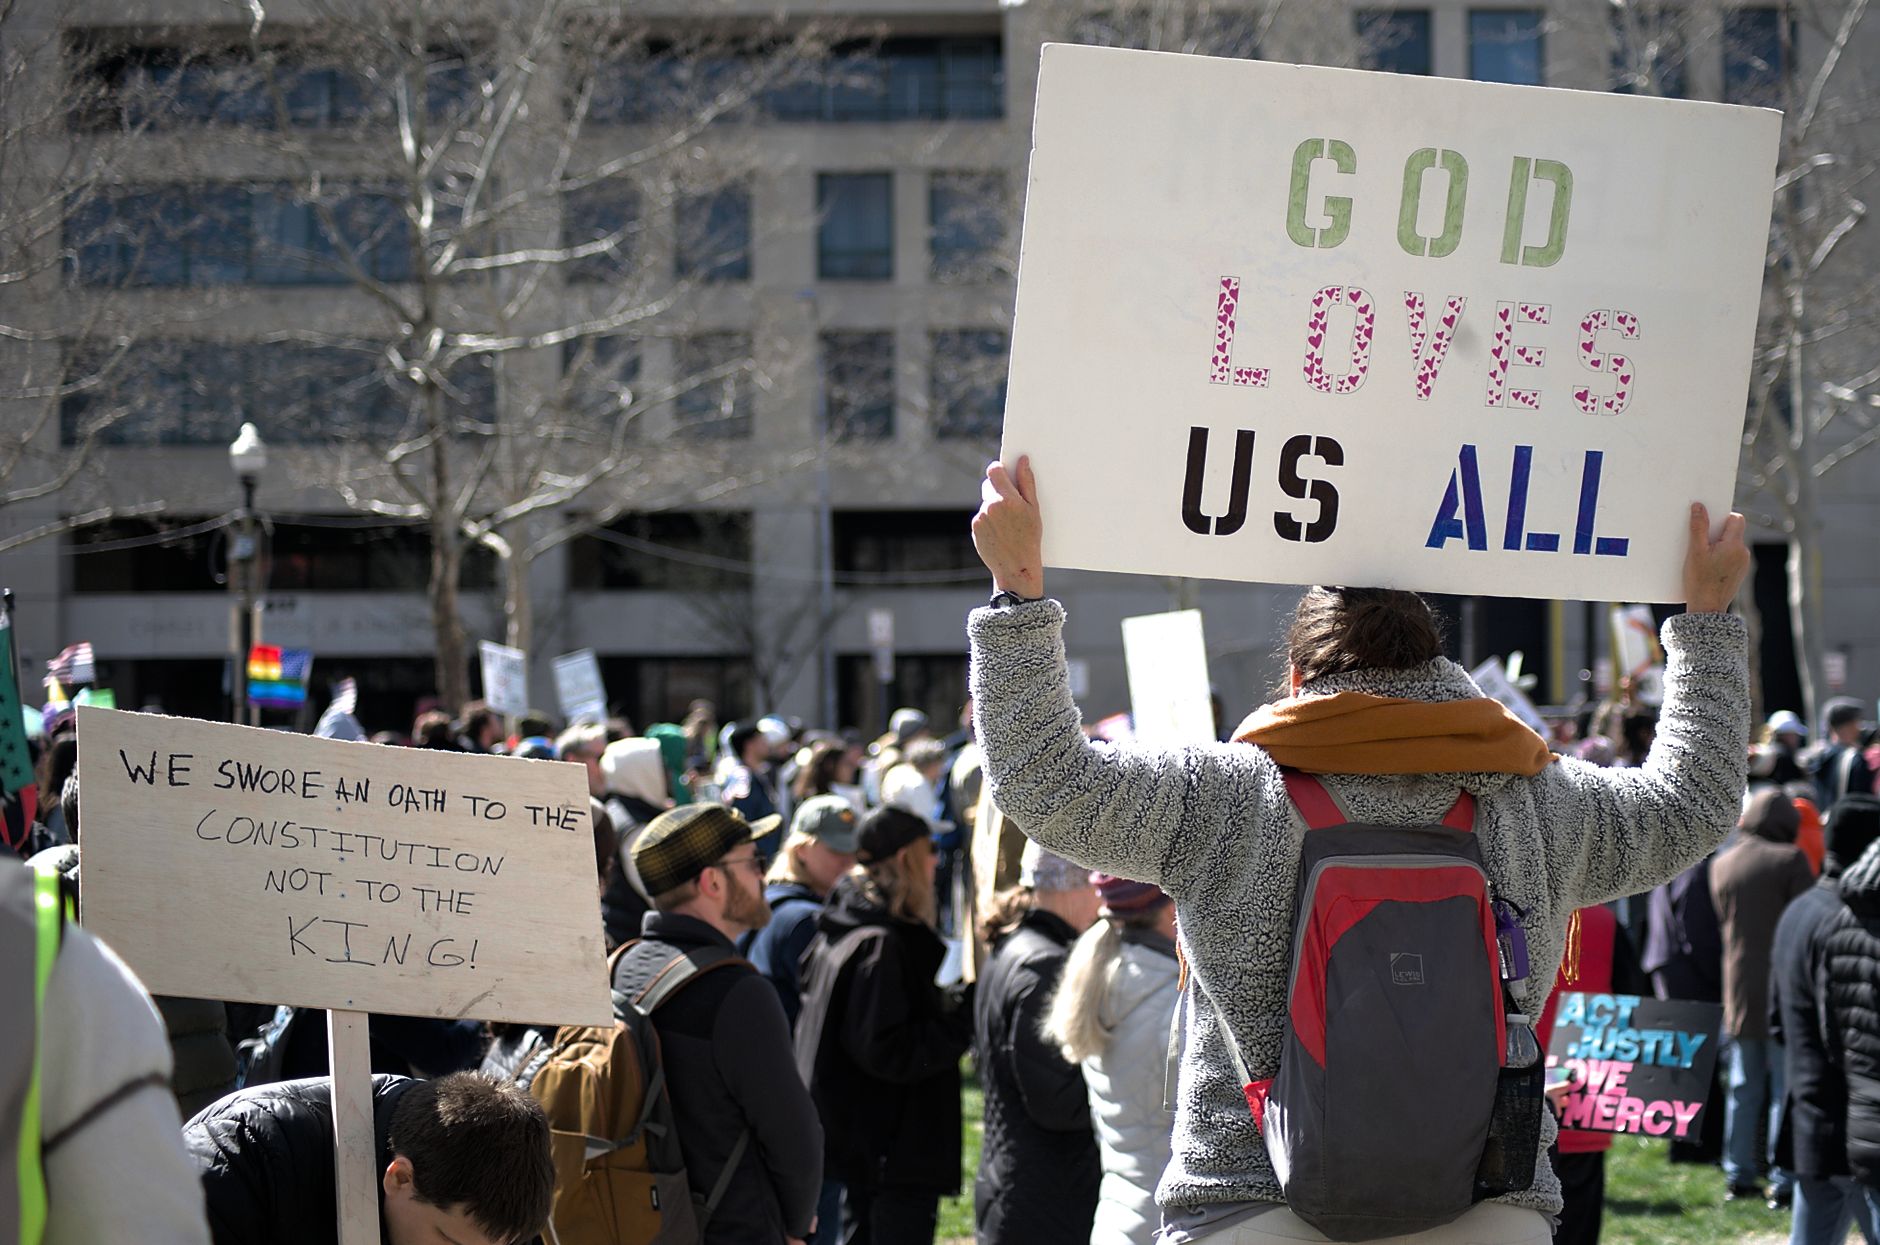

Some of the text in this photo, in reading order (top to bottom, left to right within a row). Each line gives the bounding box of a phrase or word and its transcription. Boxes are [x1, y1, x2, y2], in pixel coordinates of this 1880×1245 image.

[1286, 138, 1573, 267] GOD
[1209, 276, 1641, 416] LOVES
[1181, 426, 1629, 557] US ALL
[119, 749, 586, 831] WE SWORE AN OATH TO THE
[196, 809, 504, 876] CONSTITUTION
[265, 868, 475, 914] NOT TO THE
[287, 915, 479, 969] KING!
[1556, 992, 1641, 1030] ACT
[1567, 1024, 1707, 1068] JUSTLY
[1545, 1056, 1634, 1097] OVE
[1561, 1093, 1703, 1137] MERCY
